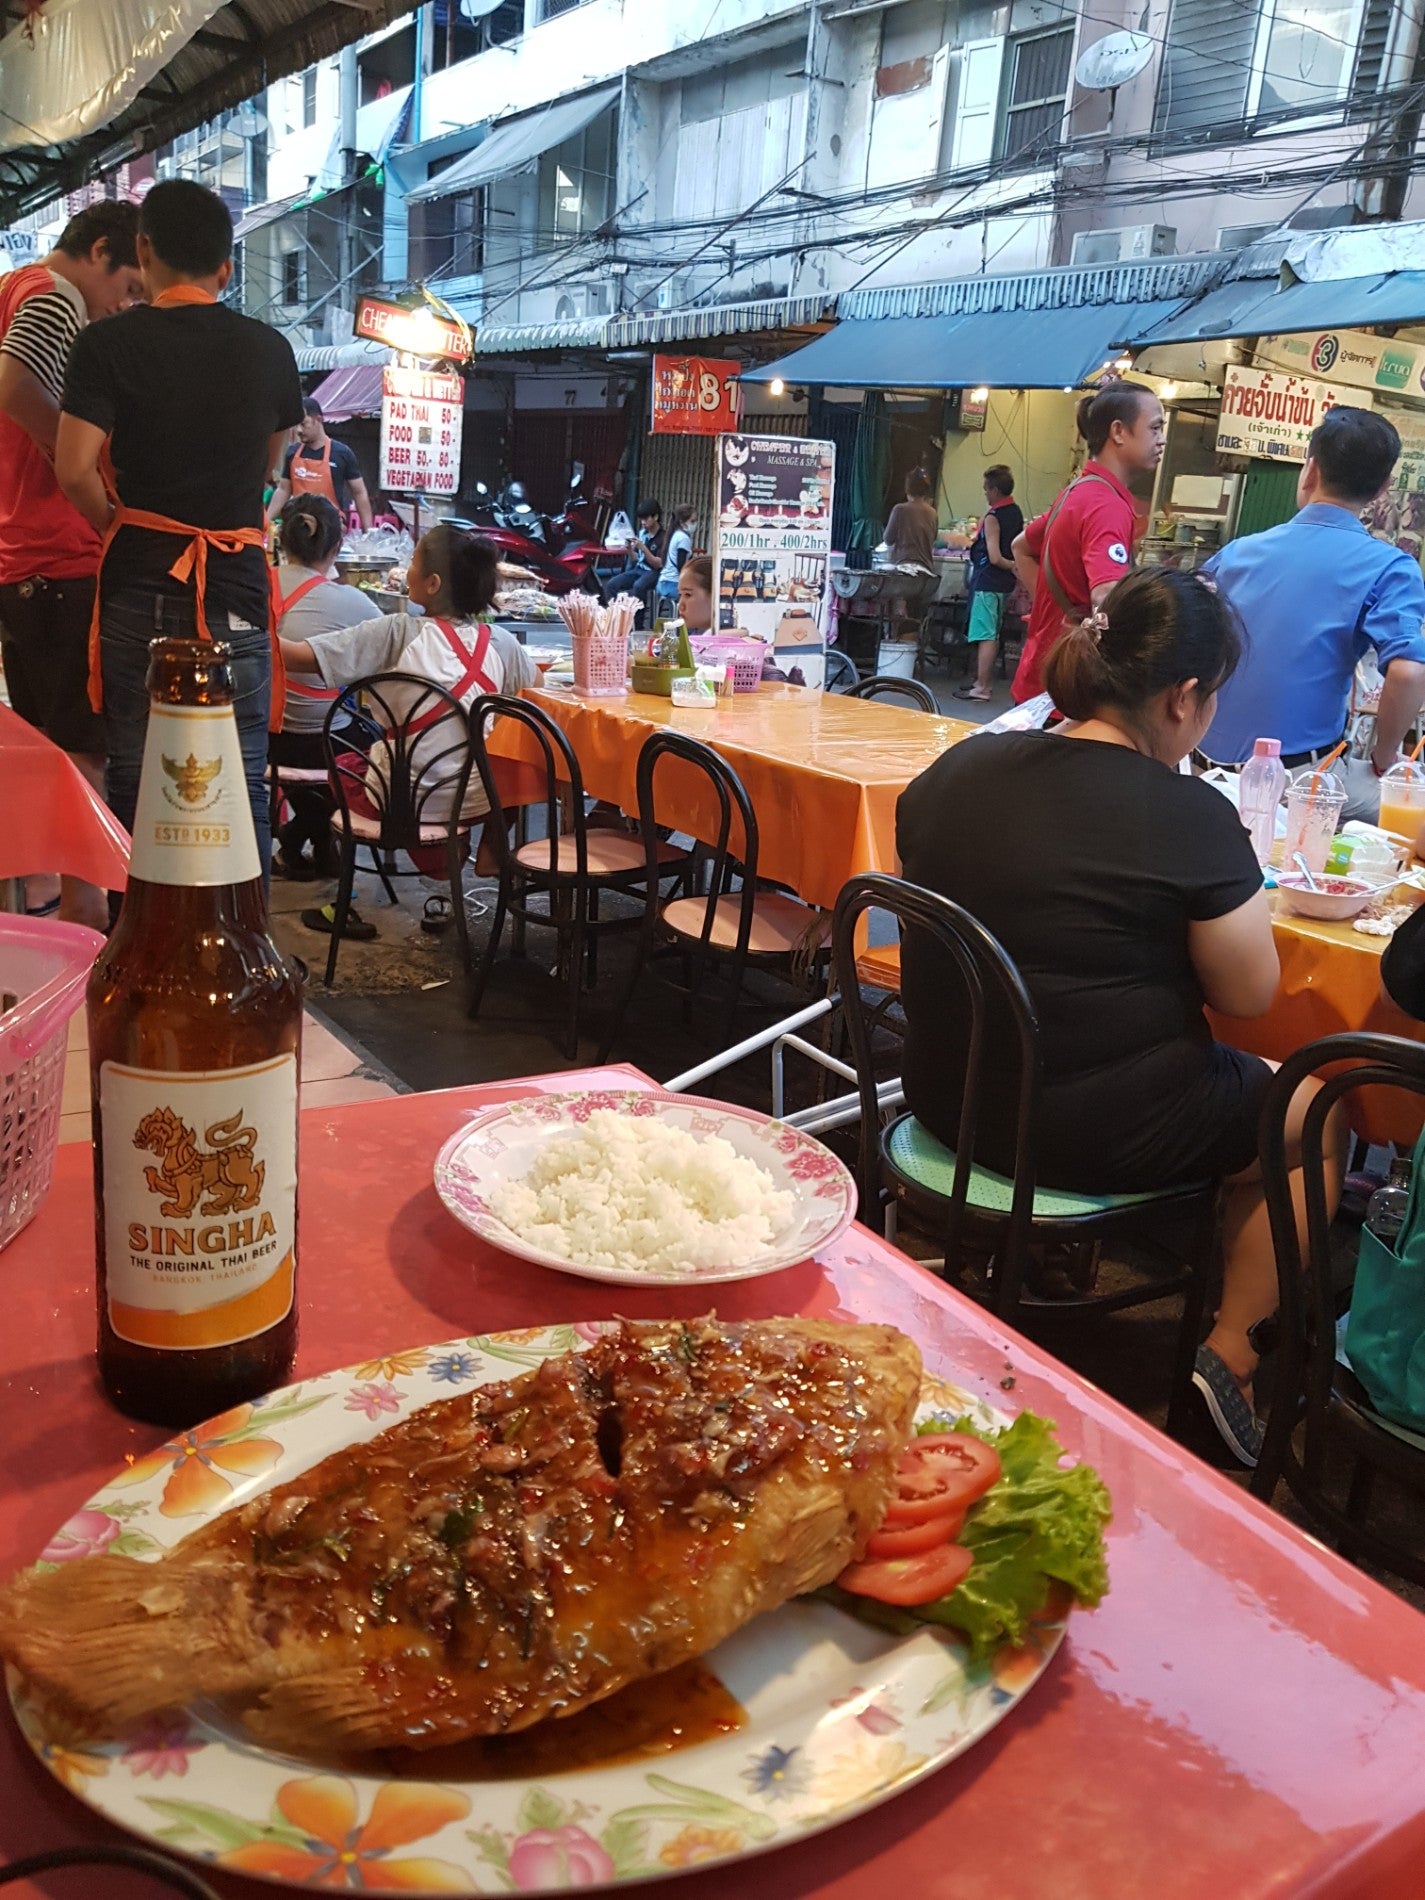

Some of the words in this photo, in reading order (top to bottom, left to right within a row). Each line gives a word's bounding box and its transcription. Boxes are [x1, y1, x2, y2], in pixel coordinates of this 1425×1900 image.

[700, 373, 737, 412] 81
[390, 402, 407, 419] PAD
[411, 404, 429, 422] THAI
[389, 425, 412, 442] FOOD
[389, 447, 411, 464] BEER
[767, 455, 799, 466] MASSAGE
[434, 473, 454, 489] FOOD
[721, 532, 770, 548] 200/1hr
[780, 533, 828, 549] 400/2hrs
[194, 829, 230, 842] 1933
[128, 1210, 277, 1255] SINGHA
[130, 1255, 151, 1269] THE
[156, 1261, 215, 1272] ORIGINAL
[220, 1253, 248, 1268] THAI
[252, 1240, 278, 1259] BEER
